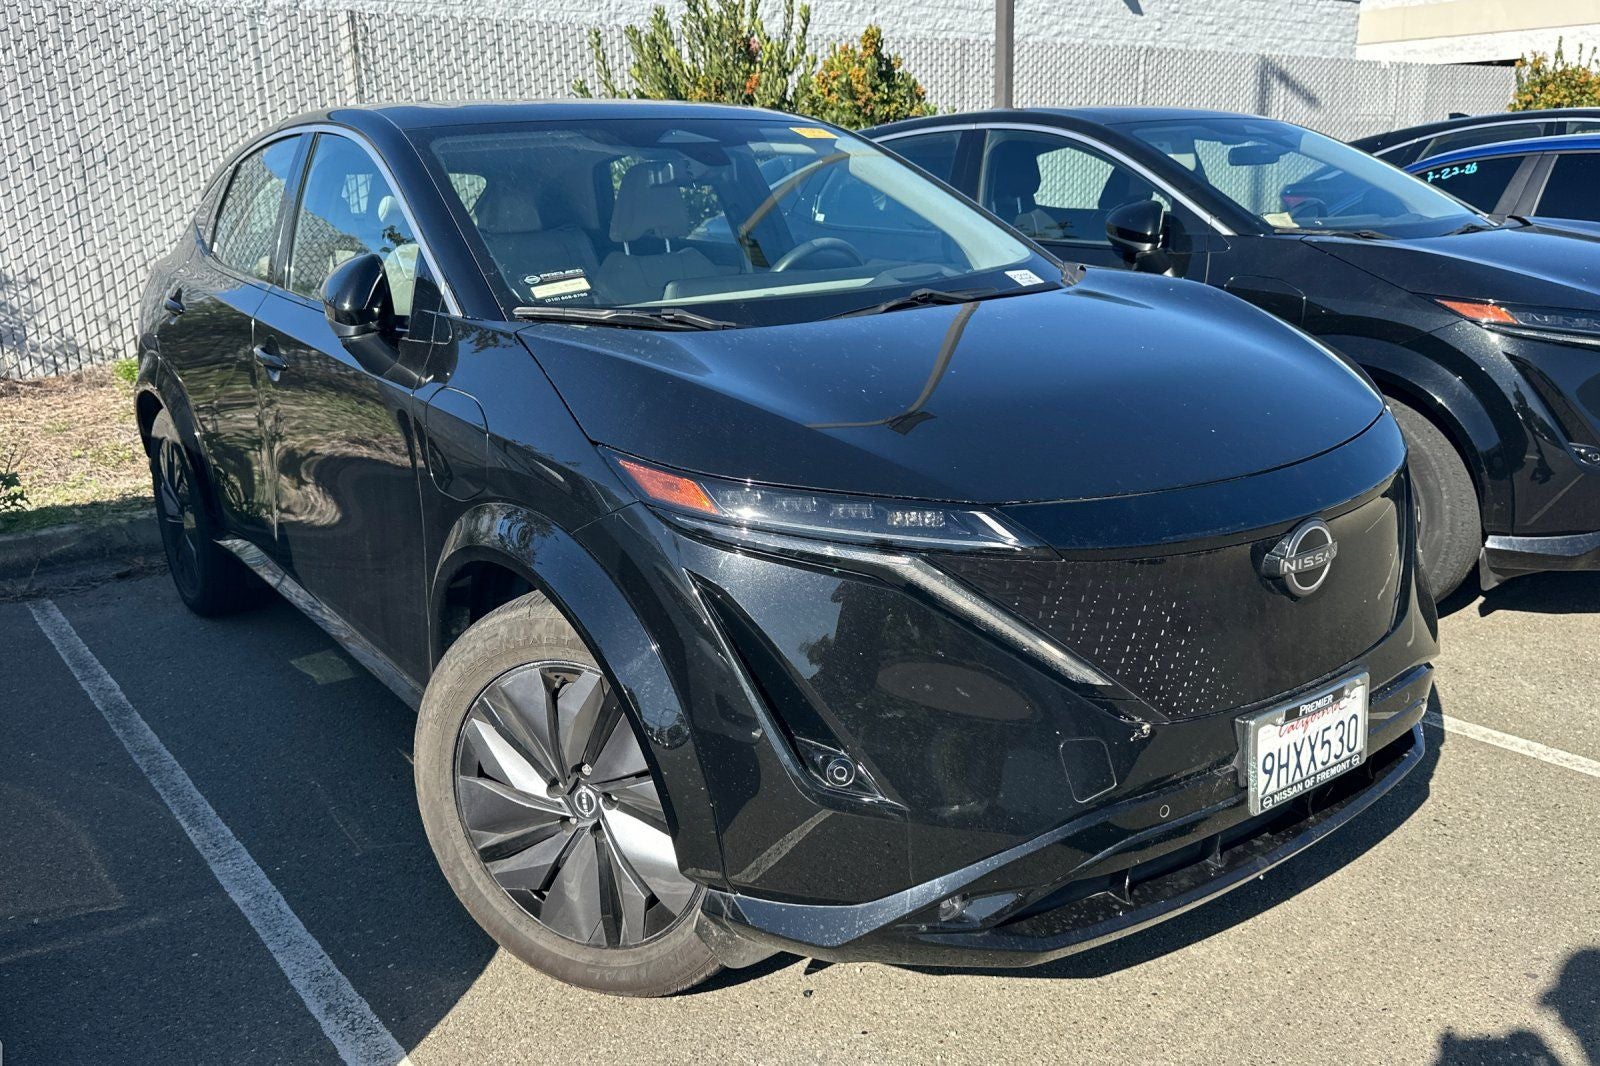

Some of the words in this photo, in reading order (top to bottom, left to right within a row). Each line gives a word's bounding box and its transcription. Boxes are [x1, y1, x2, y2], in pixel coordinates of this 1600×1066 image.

[1299, 694, 1333, 716] PREMIER
[1262, 713, 1358, 796] 9HXX530
[1273, 782, 1303, 803] NISSAN
[1304, 776, 1315, 788] OF
[1316, 760, 1350, 783] FREMONT
